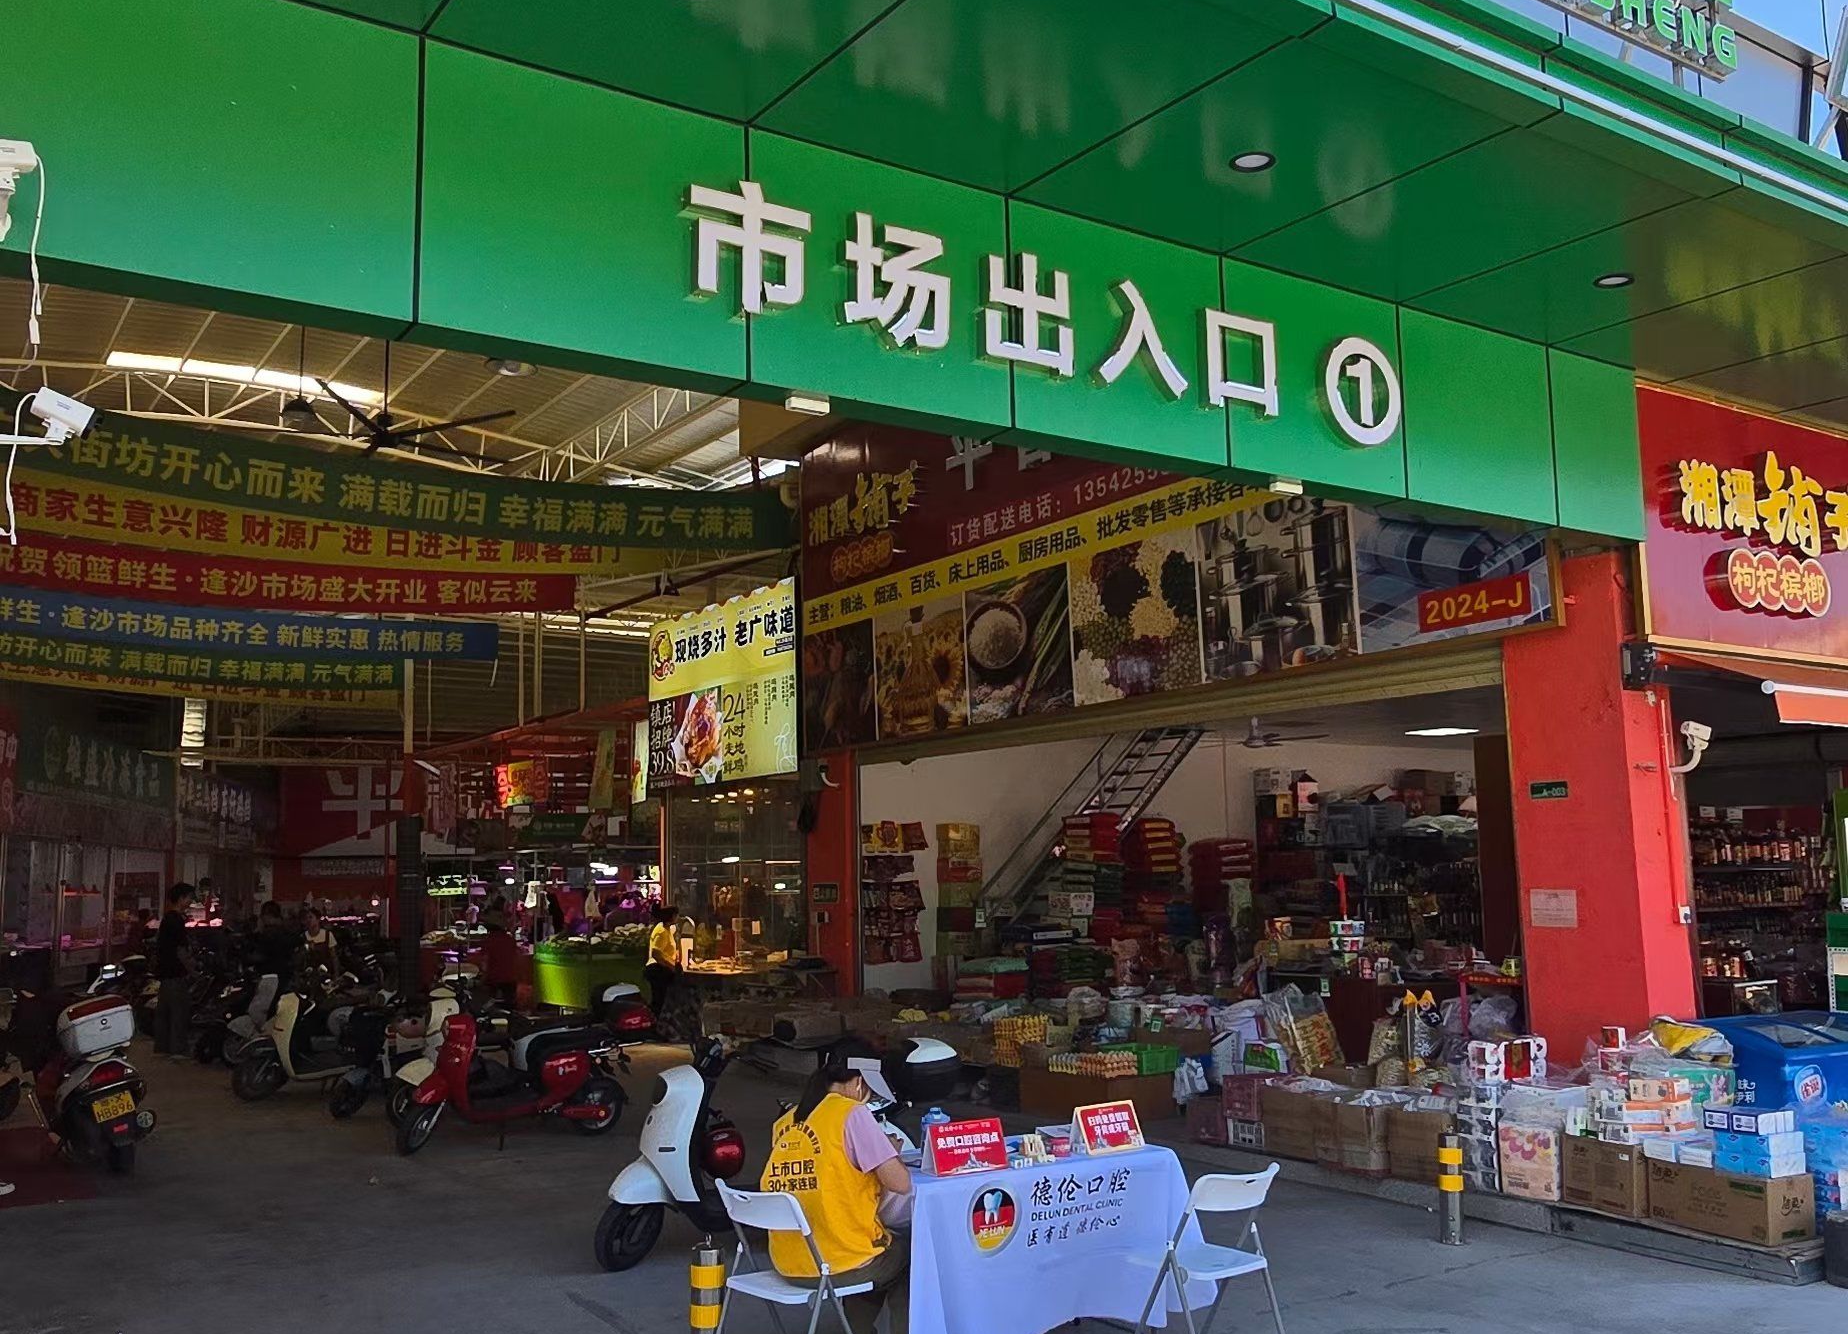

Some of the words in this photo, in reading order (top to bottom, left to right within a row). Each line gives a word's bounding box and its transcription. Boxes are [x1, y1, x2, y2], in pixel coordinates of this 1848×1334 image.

[688, 179, 1281, 418] 市场出入口
[11, 481, 229, 544] 商家生意兴隆
[241, 513, 373, 556] 财源广进
[386, 529, 503, 563] 日进斗金
[338, 472, 486, 527] 满载而归
[499, 493, 629, 536] 幸福满满
[636, 504, 755, 540] 元气满满
[437, 577, 538, 605] 客似云来
[1424, 580, 1524, 626] 2024-J
[276, 623, 371, 652] 新鲜实惠
[377, 628, 465, 653] 热情服务
[674, 626, 728, 664] 现烧多汁
[733, 604, 795, 647] 老广味道
[119, 648, 212, 680] 满载而归
[217, 658, 306, 685] 幸福满满
[311, 662, 394, 685] 元气满满
[723, 692, 745, 723] 24
[650, 750, 675, 776] 39.8
[768, 1158, 815, 1178] 上市口腔
[1030, 1166, 1131, 1207] 德伦口腔
[1030, 1208, 1061, 1223] DELUN
[1062, 1203, 1094, 1218] DENTAL
[1095, 1197, 1124, 1210] CLINIC
